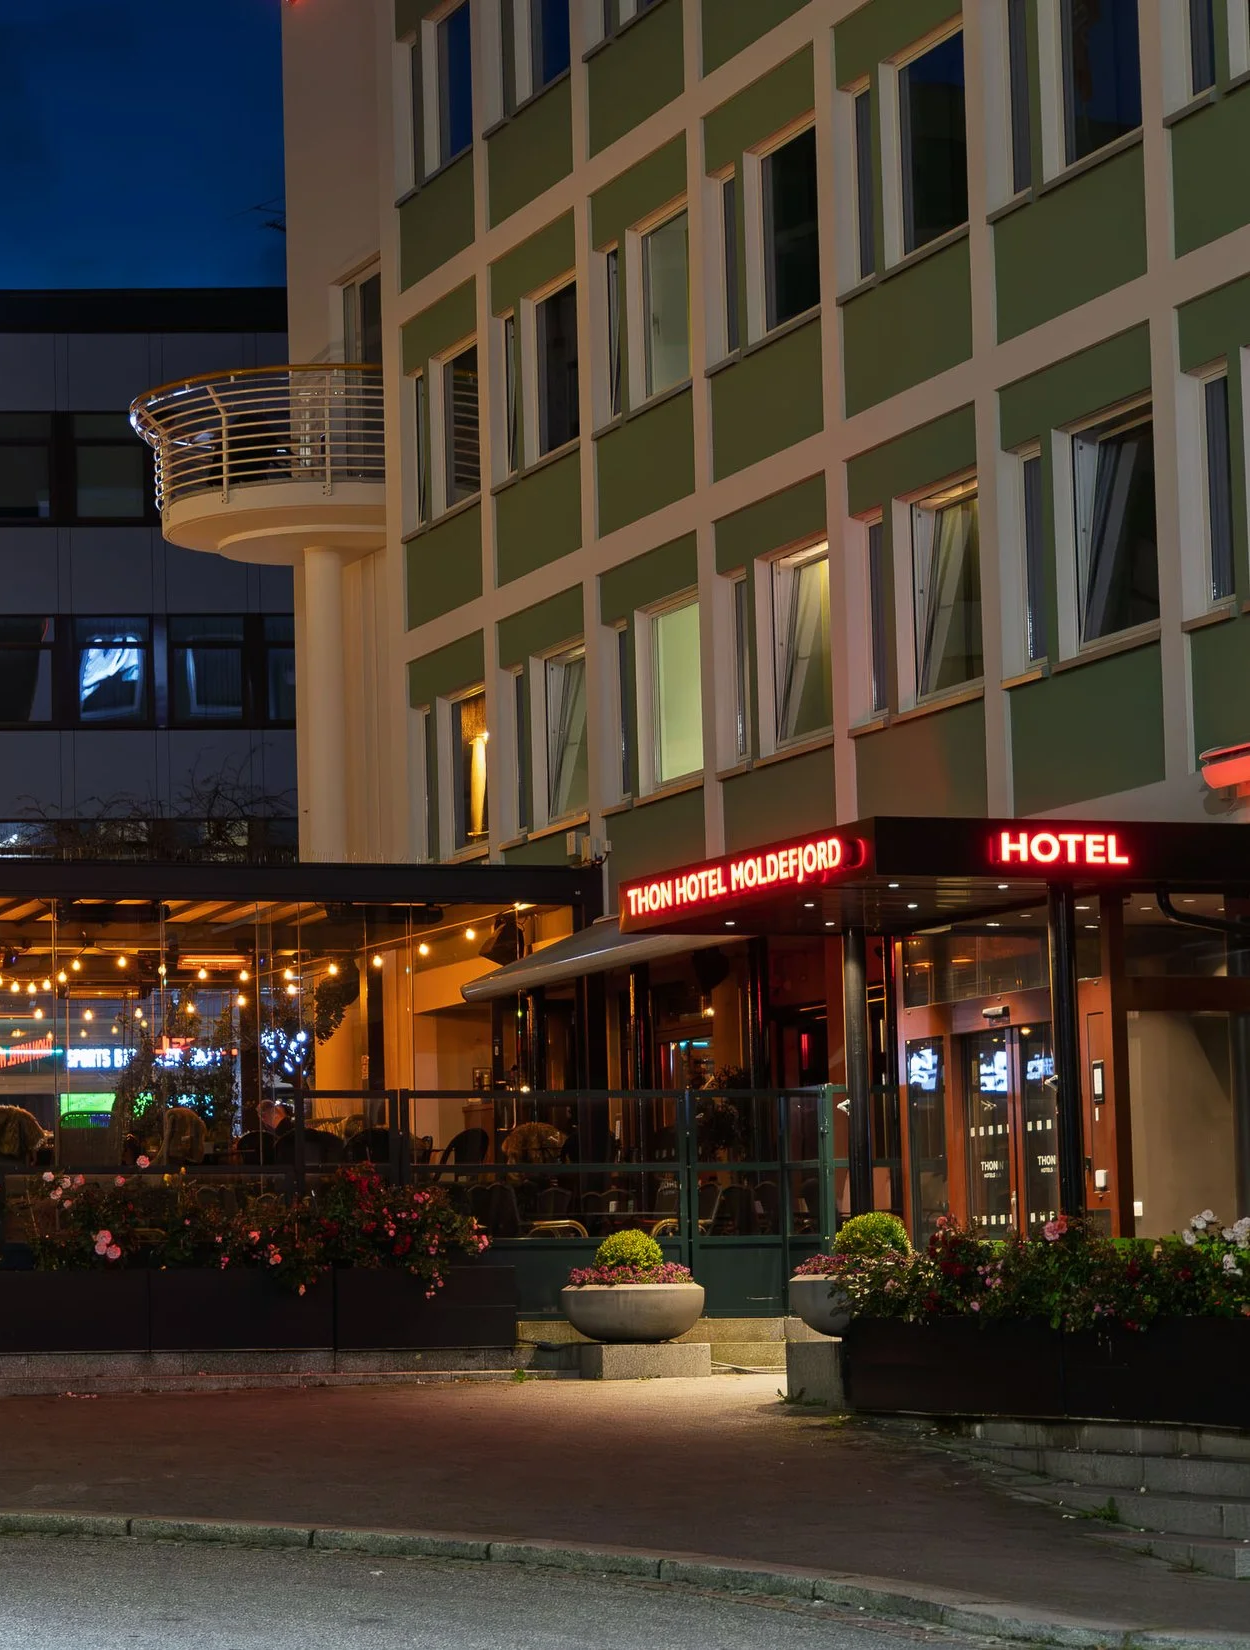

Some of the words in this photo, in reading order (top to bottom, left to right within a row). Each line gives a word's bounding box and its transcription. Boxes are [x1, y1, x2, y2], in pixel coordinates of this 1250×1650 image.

[1001, 832, 1129, 864] HOTEL
[627, 880, 672, 916] THON
[675, 867, 727, 906] HOTEL
[730, 838, 841, 892] MOLDEFJORD
[67, 1049, 112, 1068] SPORTS
[981, 1161, 998, 1171] THON
[1037, 1155, 1056, 1165] THON
